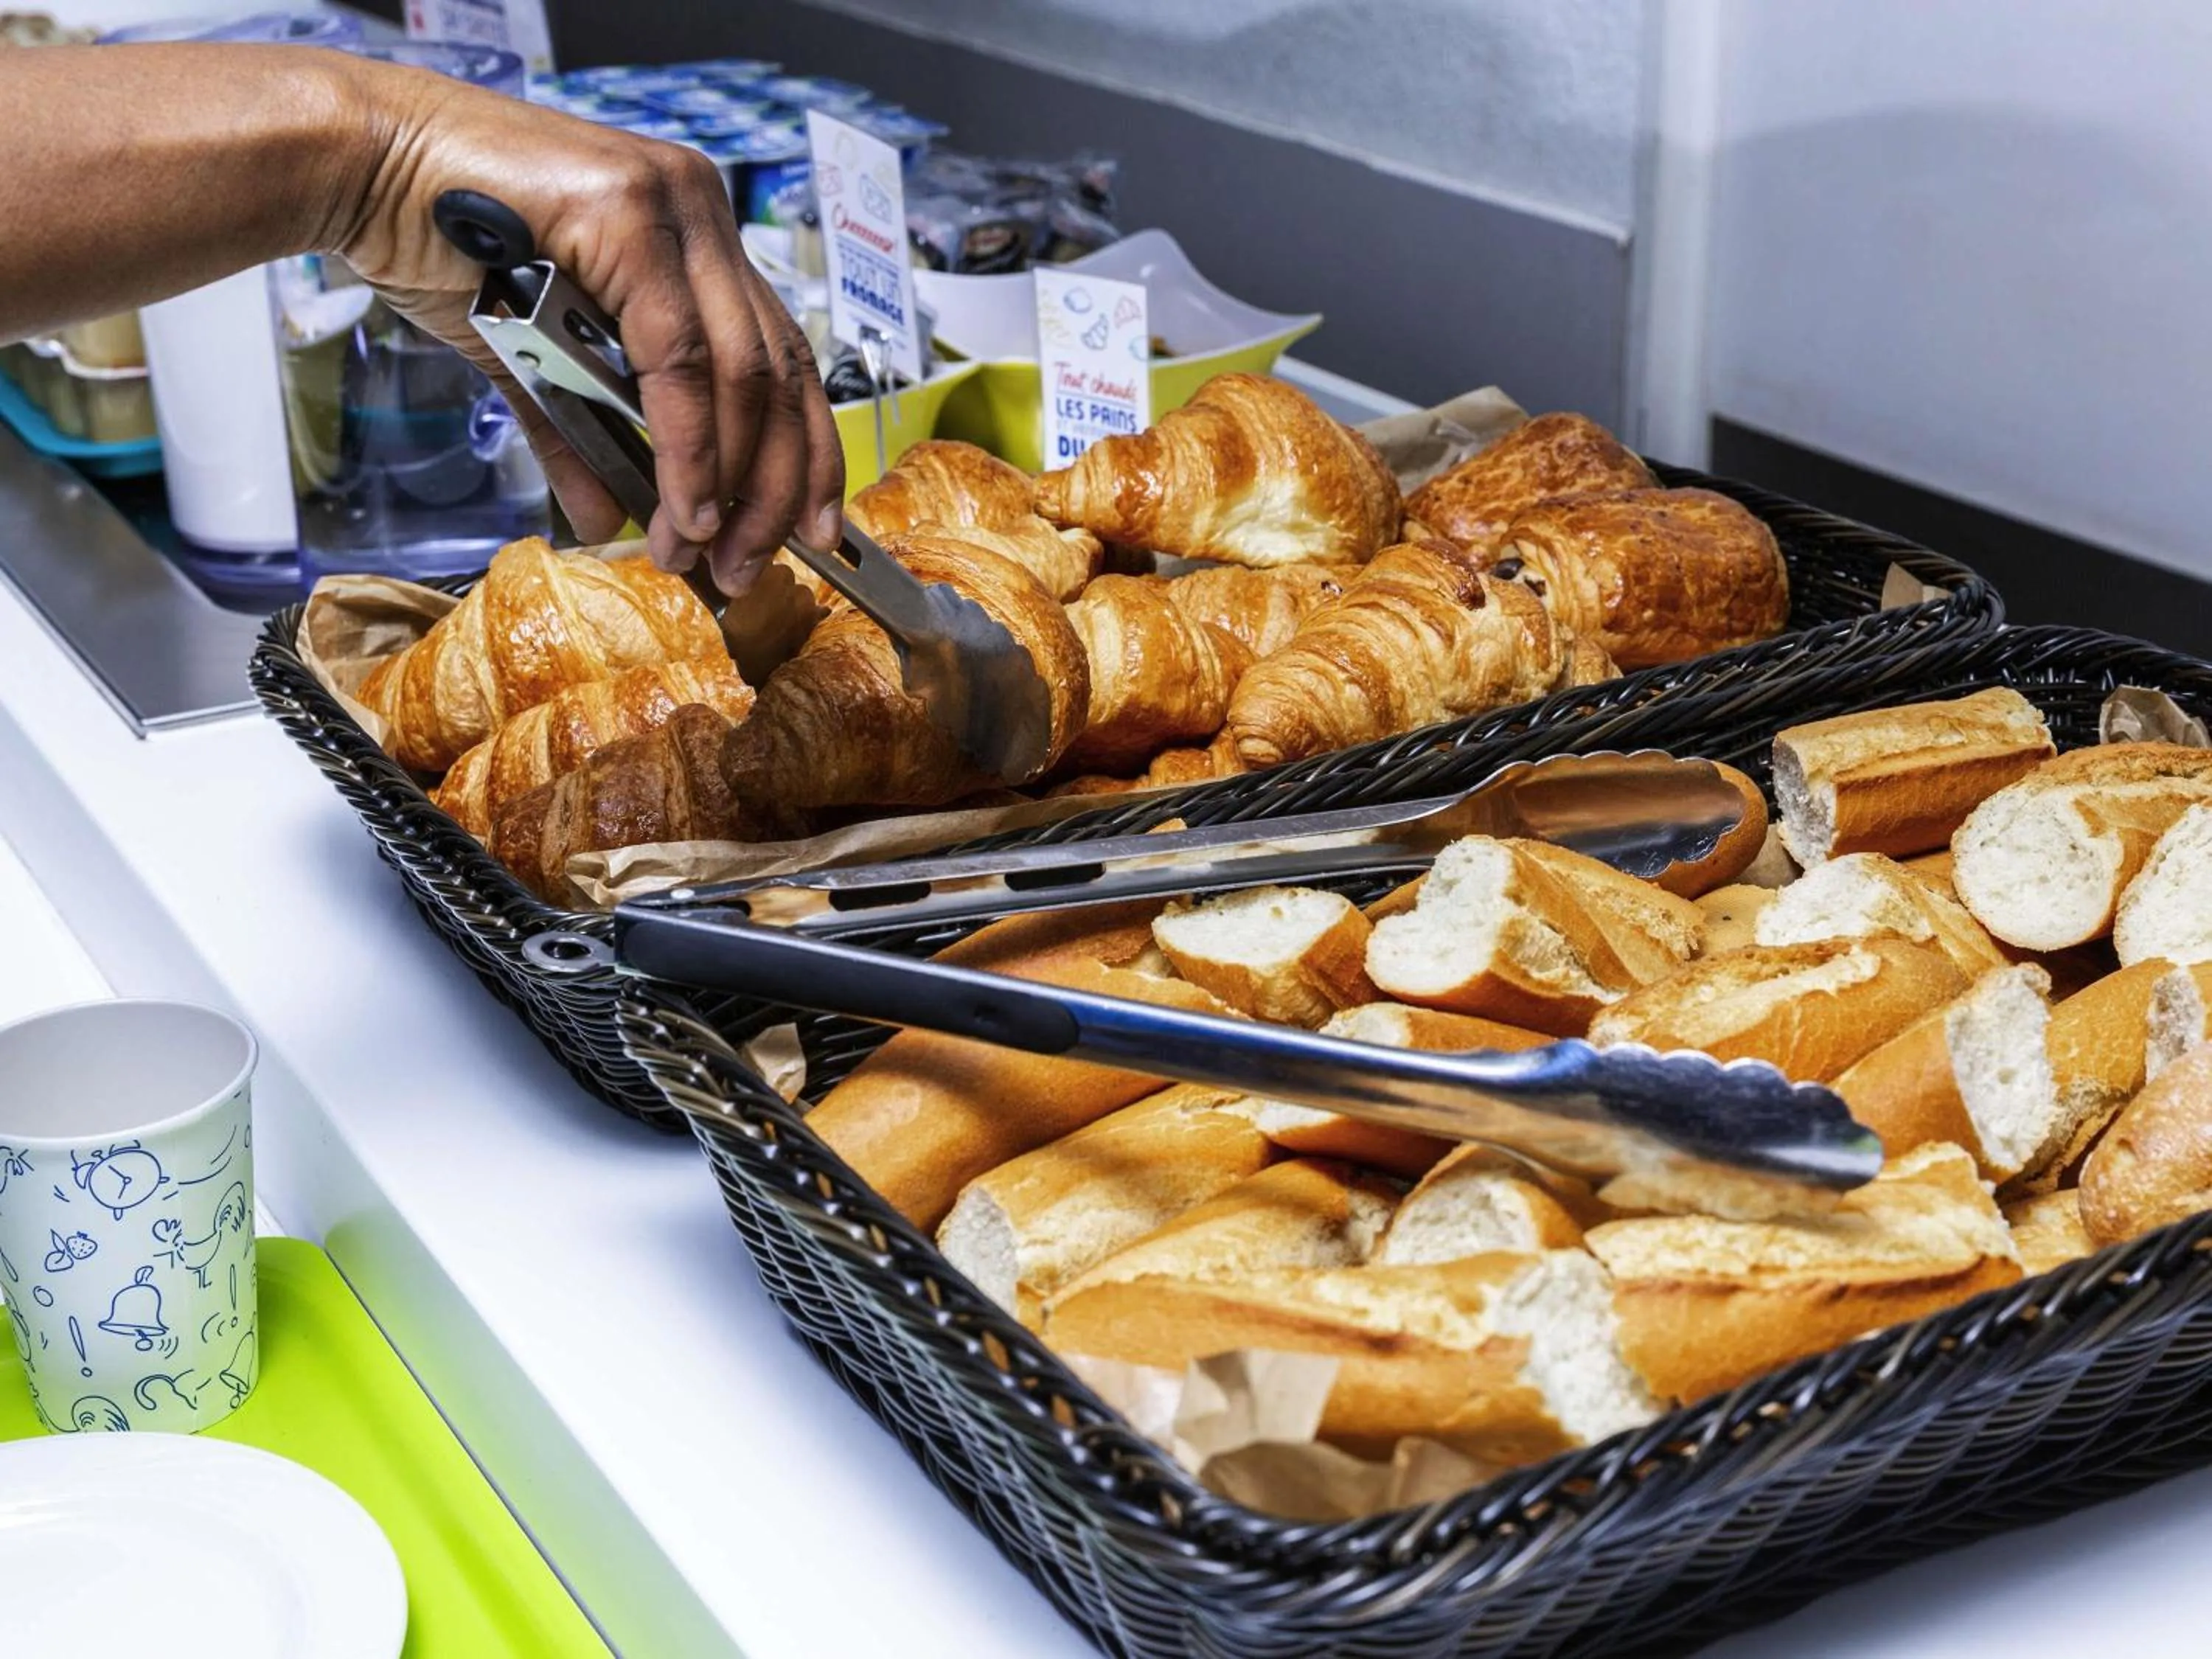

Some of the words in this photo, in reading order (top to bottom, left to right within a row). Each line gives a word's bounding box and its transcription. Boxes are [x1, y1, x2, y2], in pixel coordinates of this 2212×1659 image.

[841, 276, 904, 326] FROMAGE
[1056, 397, 1085, 420] LES
[1090, 403, 1137, 434] PAINS
[1058, 435, 1085, 458] DU
